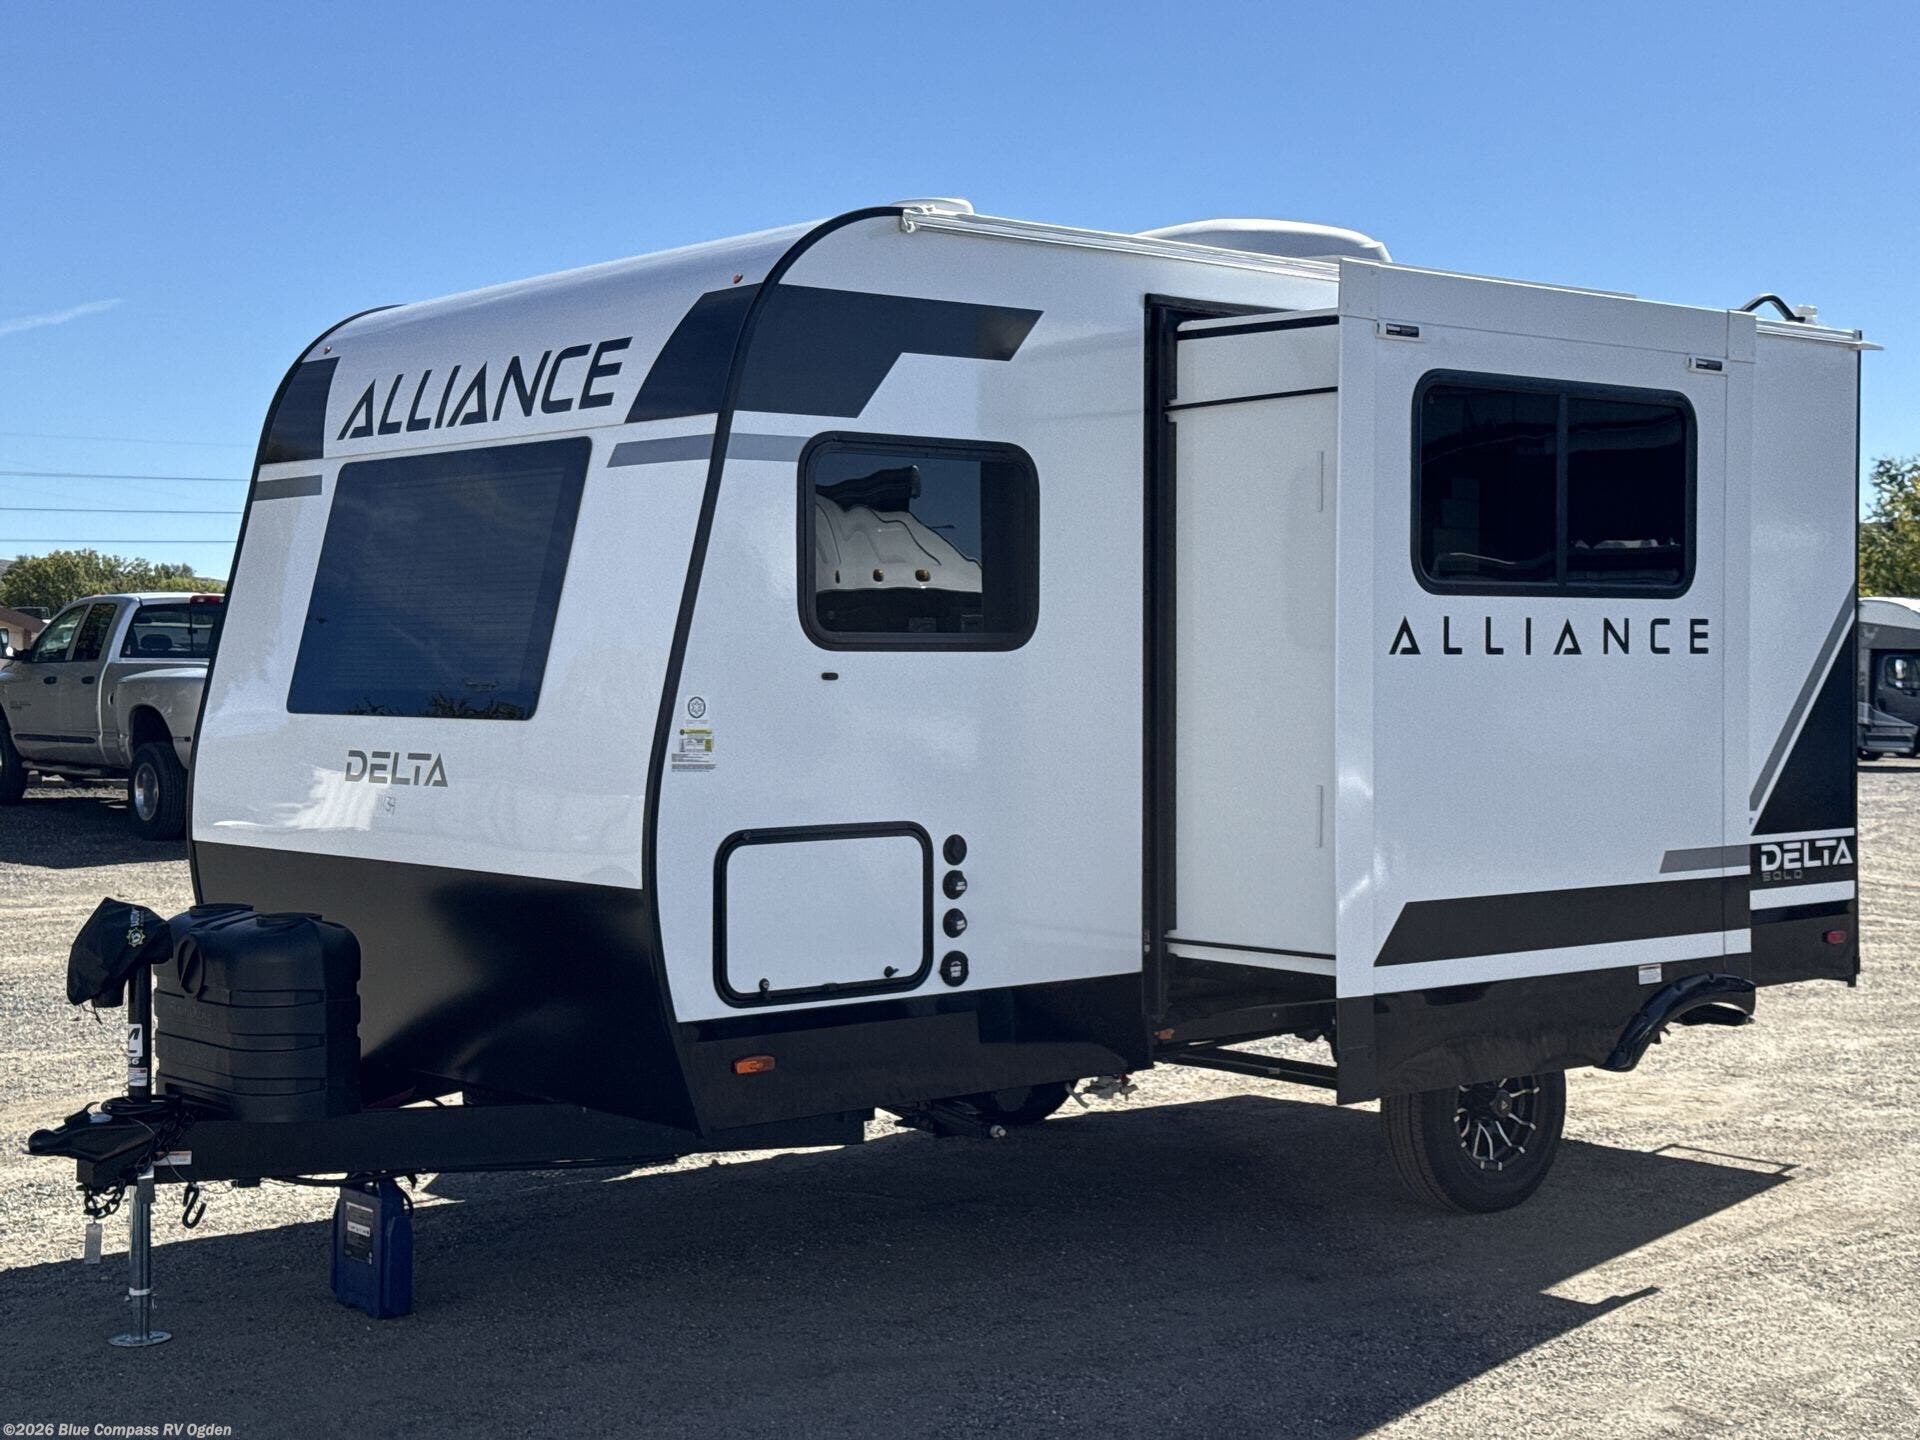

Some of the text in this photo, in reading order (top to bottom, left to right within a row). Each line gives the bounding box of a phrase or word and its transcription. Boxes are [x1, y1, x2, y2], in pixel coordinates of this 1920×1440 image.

[336, 336, 634, 441] ALLIANCE
[1389, 616, 1709, 655] ALLIANCE
[345, 749, 448, 787] DELTA
[1761, 838, 1854, 872] DELTA
[1762, 869, 1803, 881] SOLO
